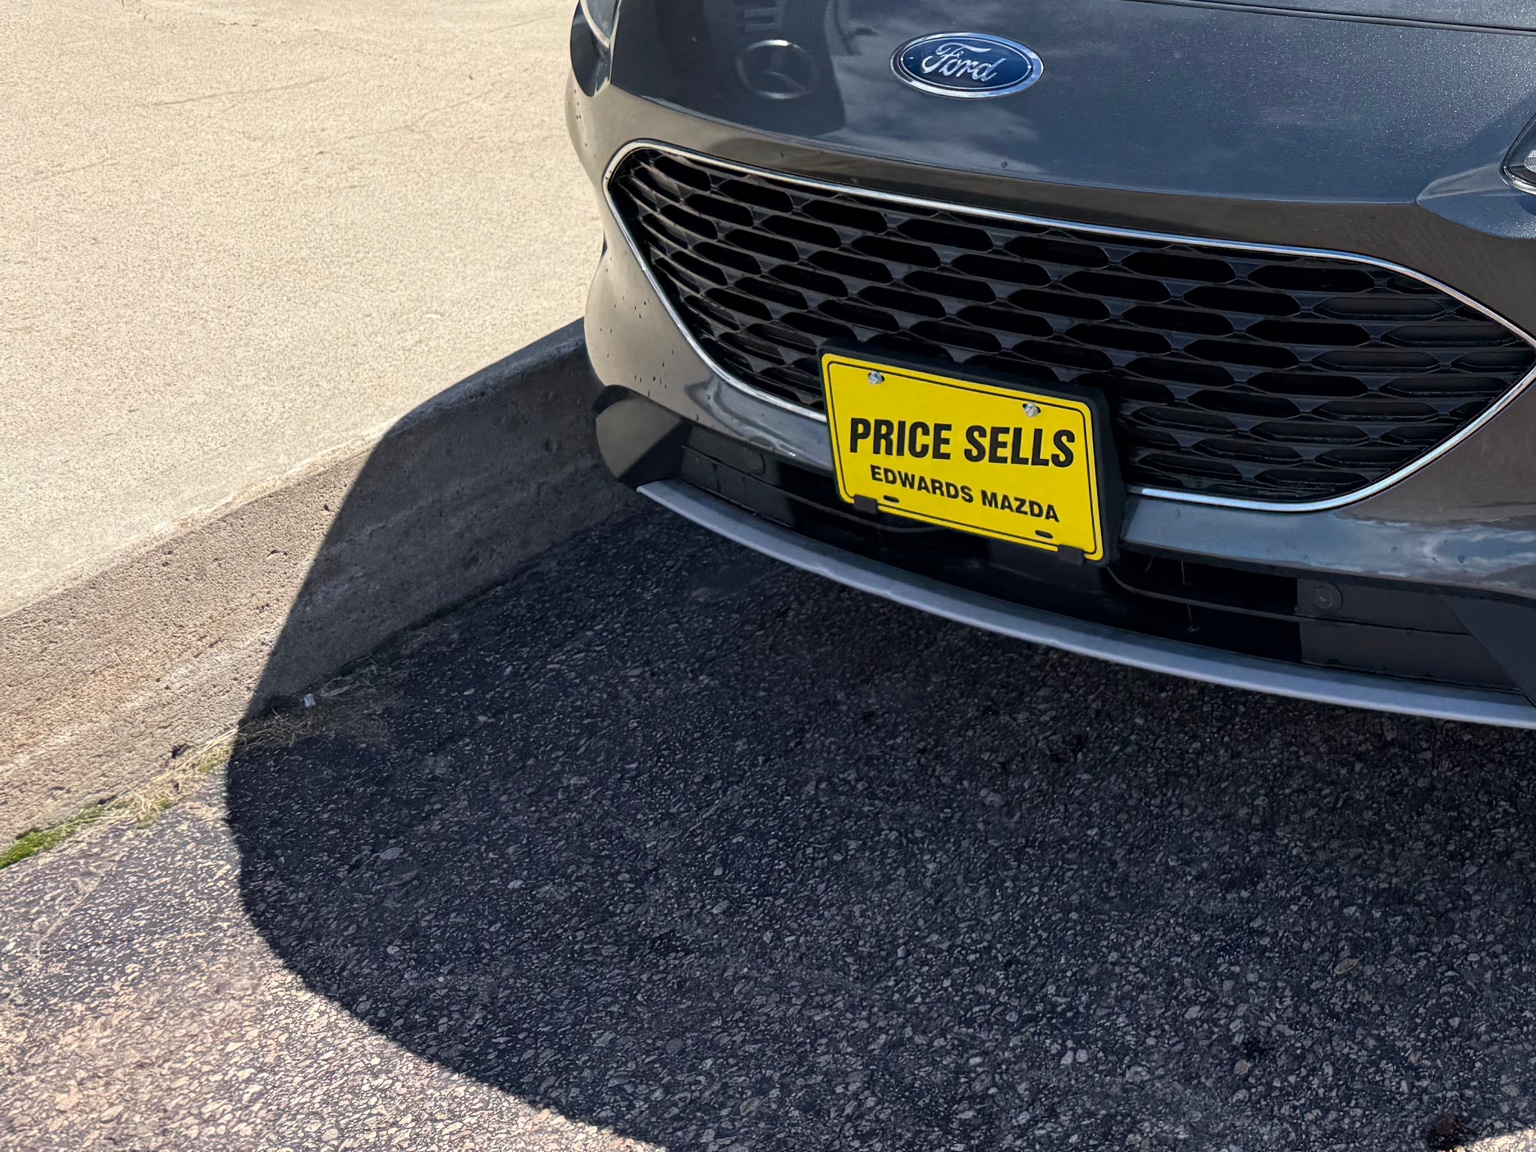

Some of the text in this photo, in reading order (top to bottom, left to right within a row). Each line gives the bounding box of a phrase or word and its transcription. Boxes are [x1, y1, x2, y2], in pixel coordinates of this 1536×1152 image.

[921, 42, 1007, 82] Ford
[849, 417, 1076, 468] PRICE SELLS
[870, 464, 1060, 523] EDWARDS MAZDA
